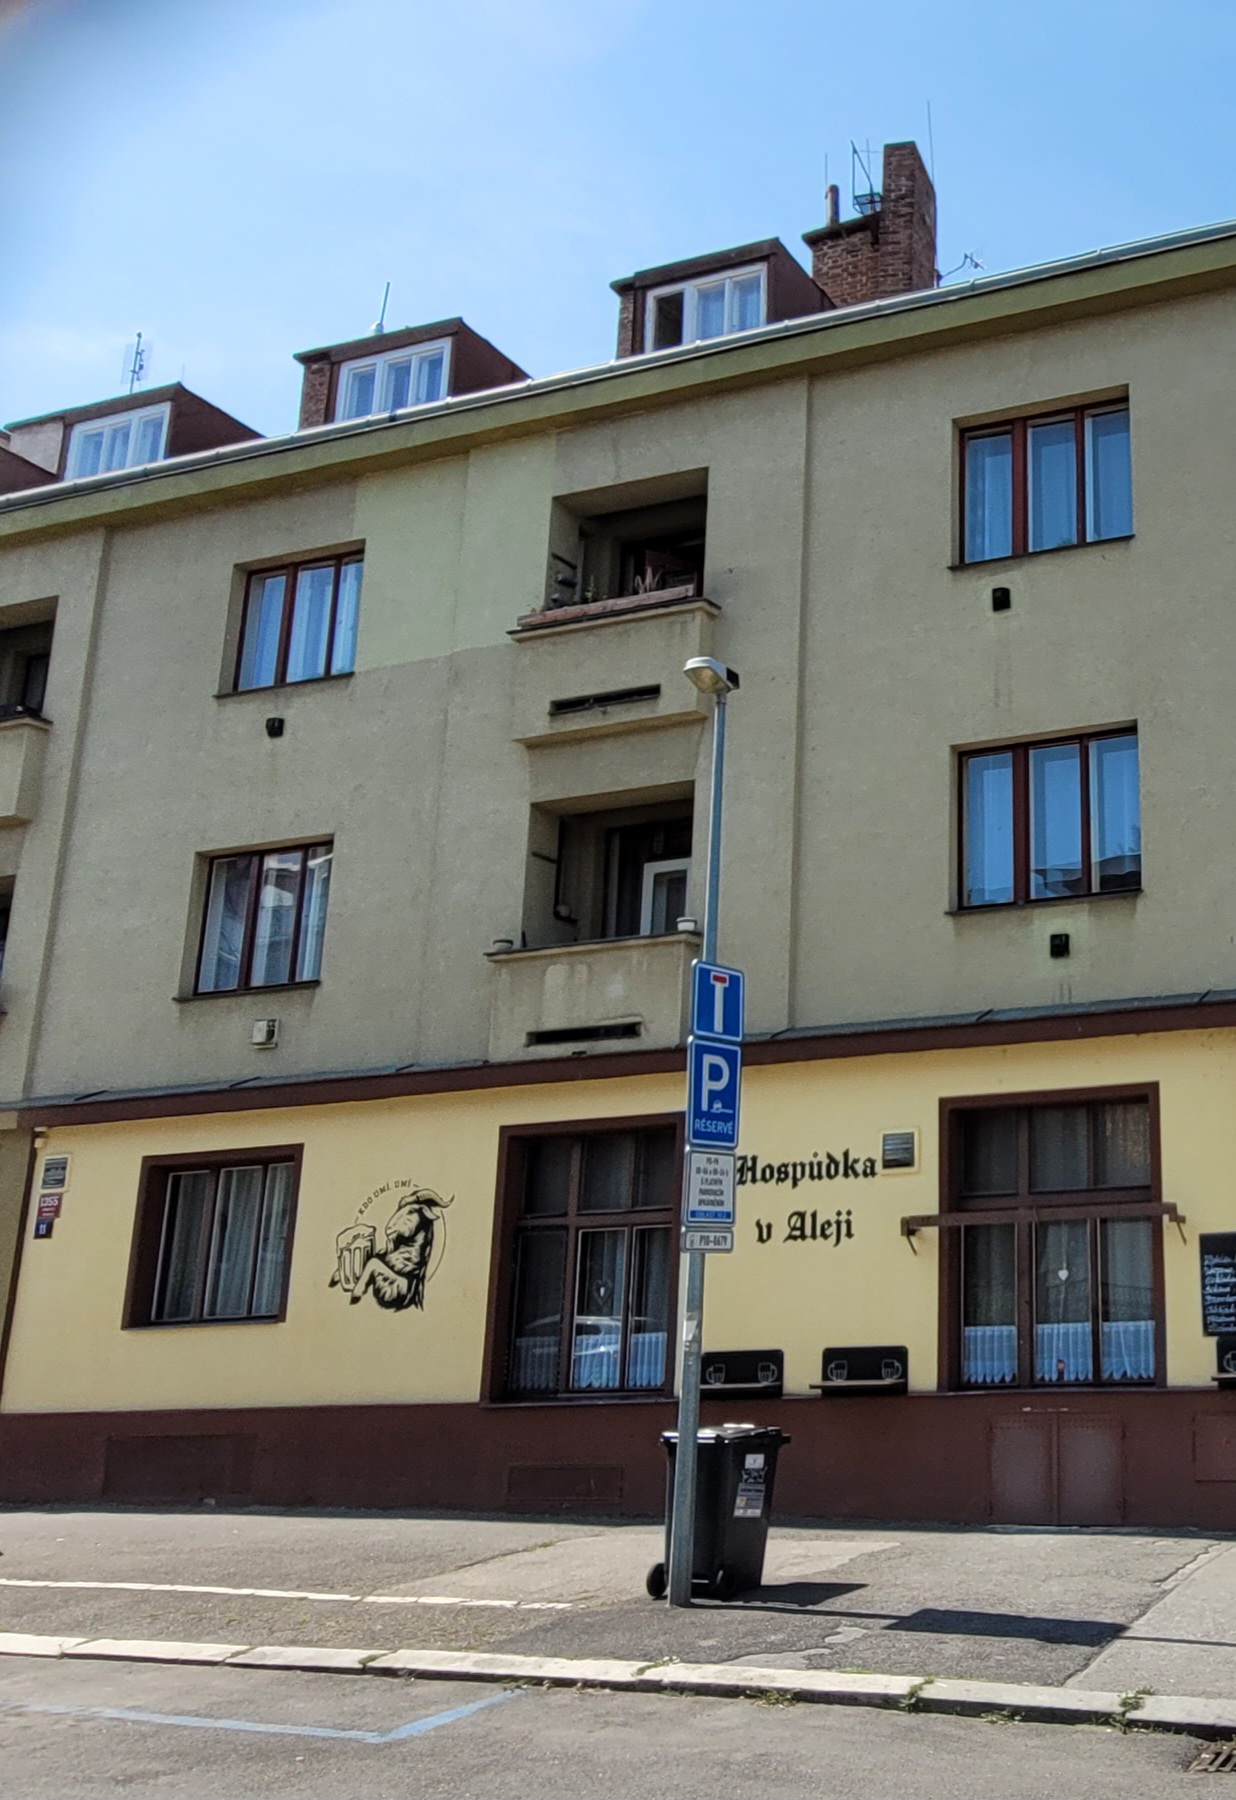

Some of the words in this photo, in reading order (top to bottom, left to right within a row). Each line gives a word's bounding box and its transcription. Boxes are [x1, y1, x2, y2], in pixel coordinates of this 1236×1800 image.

[701, 1053, 730, 1112] P
[694, 1117, 733, 1135] RÉSERVÉ
[358, 1196, 374, 1215] KDO
[373, 1182, 390, 1198] UMÍ
[394, 1178, 412, 1188] UMÍ
[755, 1218, 773, 1244] v
[782, 1208, 855, 1248] Aleji
